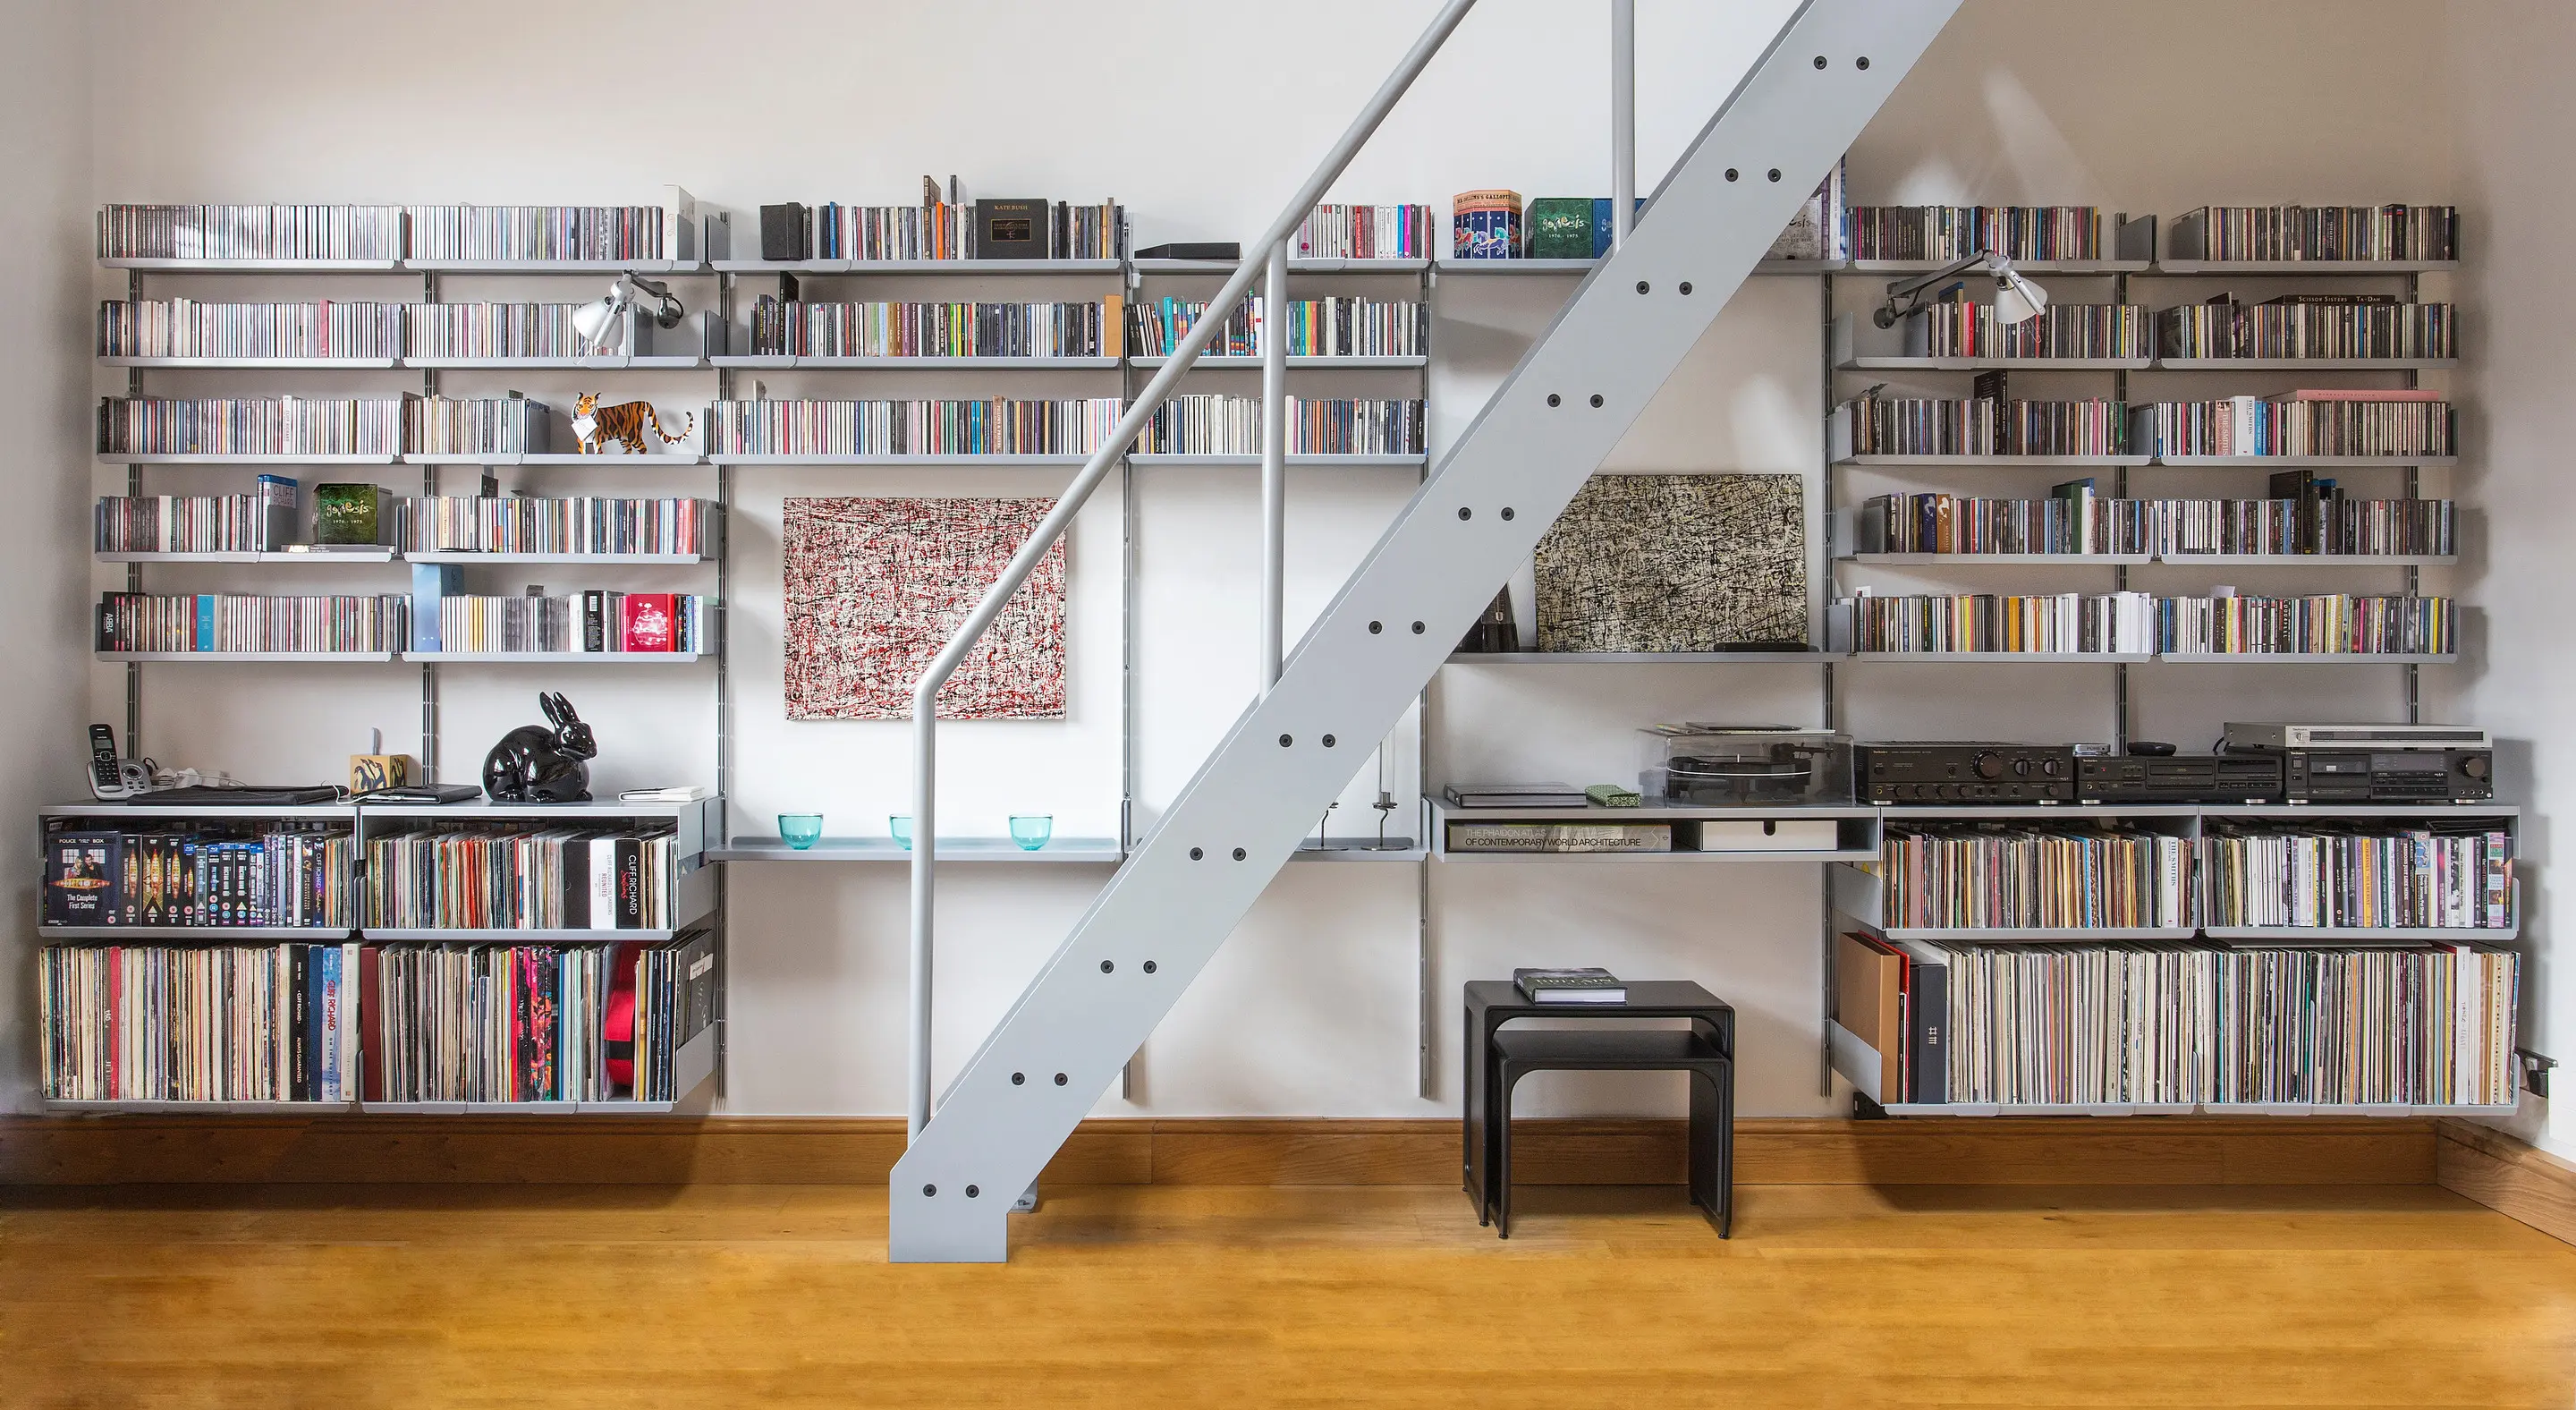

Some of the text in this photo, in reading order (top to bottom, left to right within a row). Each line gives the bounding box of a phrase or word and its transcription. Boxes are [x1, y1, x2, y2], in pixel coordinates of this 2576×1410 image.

[1542, 214, 1585, 233] genesis
[273, 484, 294, 499] CLIFF
[273, 497, 294, 506] RICHARD
[326, 499, 369, 517] genesis
[288, 545, 309, 553] ABBA
[106, 613, 114, 633] ABBA
[1466, 828, 1546, 837] THE PHAIDON ATLAS
[1465, 837, 1641, 846] OF CONTEMPORARY WORLD ARCHITECTURE
[628, 854, 638, 915] CLIFF RICHARD
[76, 894, 98, 902] Complete
[1536, 977, 1612, 985] BRITAIN
[326, 980, 336, 998] CLIFF
[326, 998, 336, 1032] RICHARD
